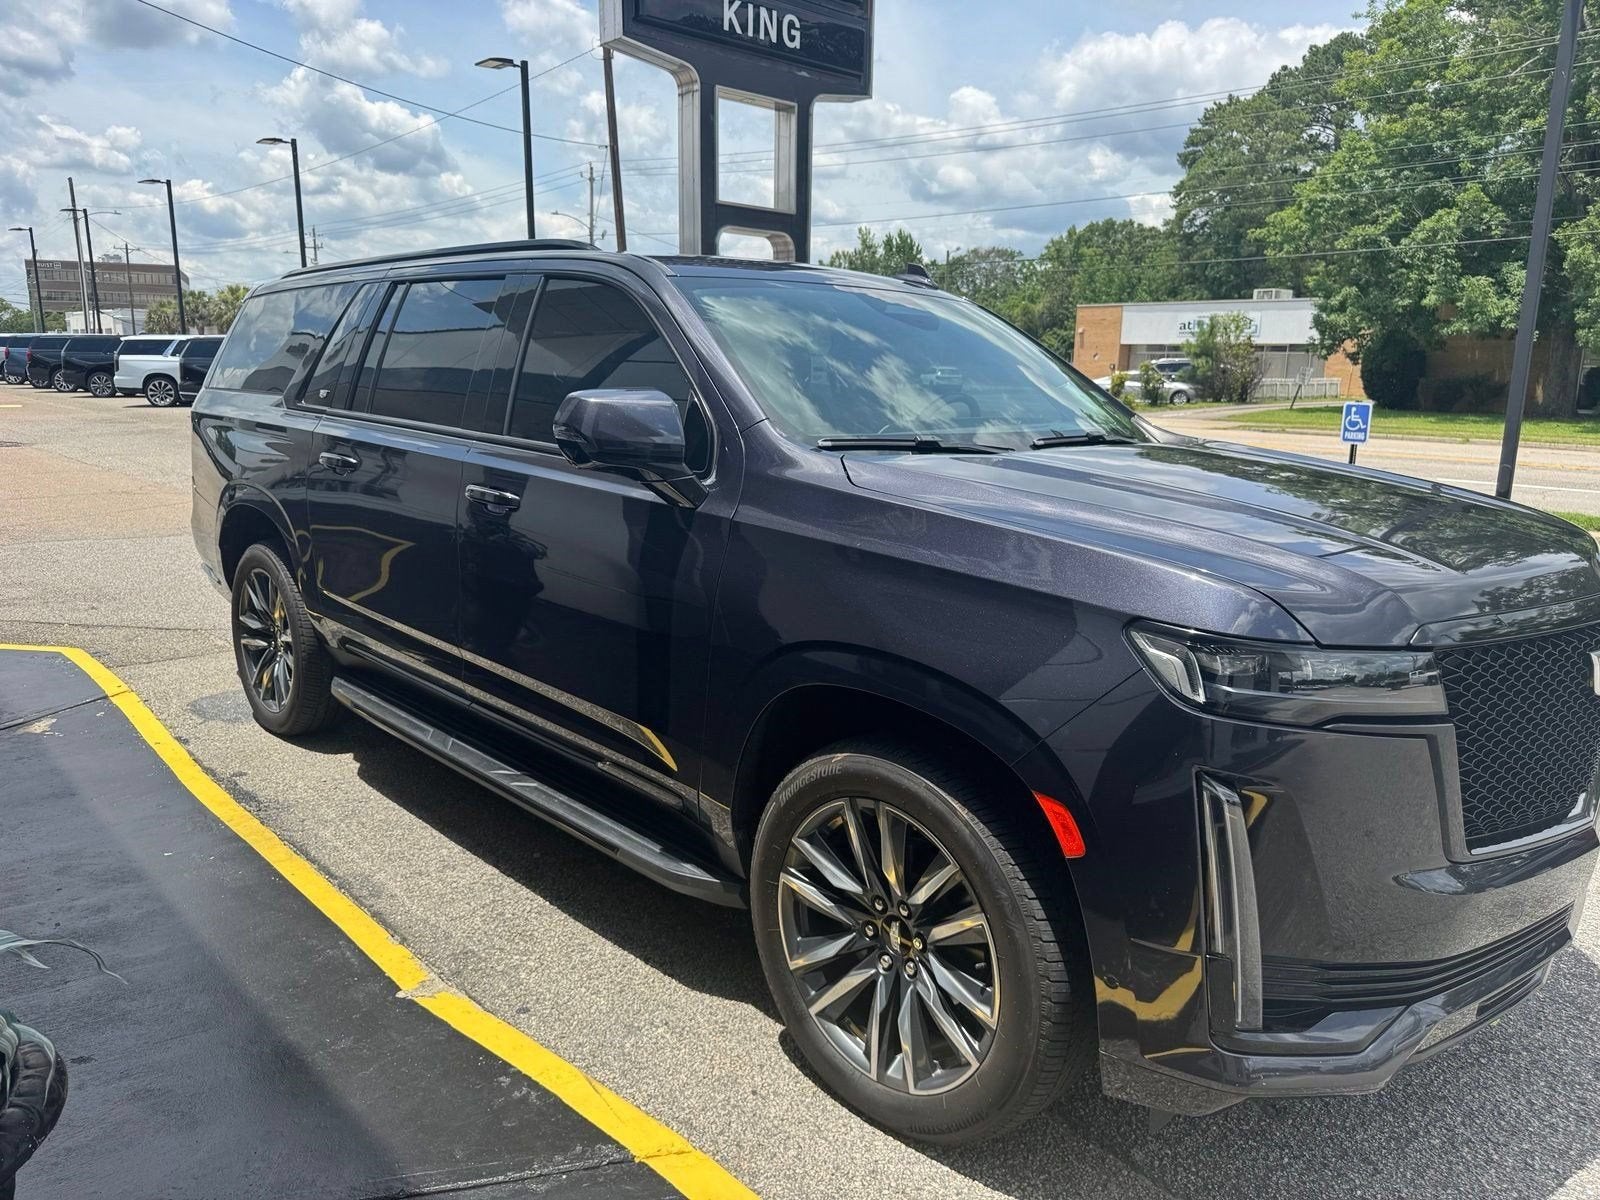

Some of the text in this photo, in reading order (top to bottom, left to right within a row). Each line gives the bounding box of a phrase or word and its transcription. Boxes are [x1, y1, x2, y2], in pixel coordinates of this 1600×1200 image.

[722, 0, 801, 49] KING
[1344, 431, 1366, 440] PARKING
[780, 763, 843, 808] BRIDGESTONE
